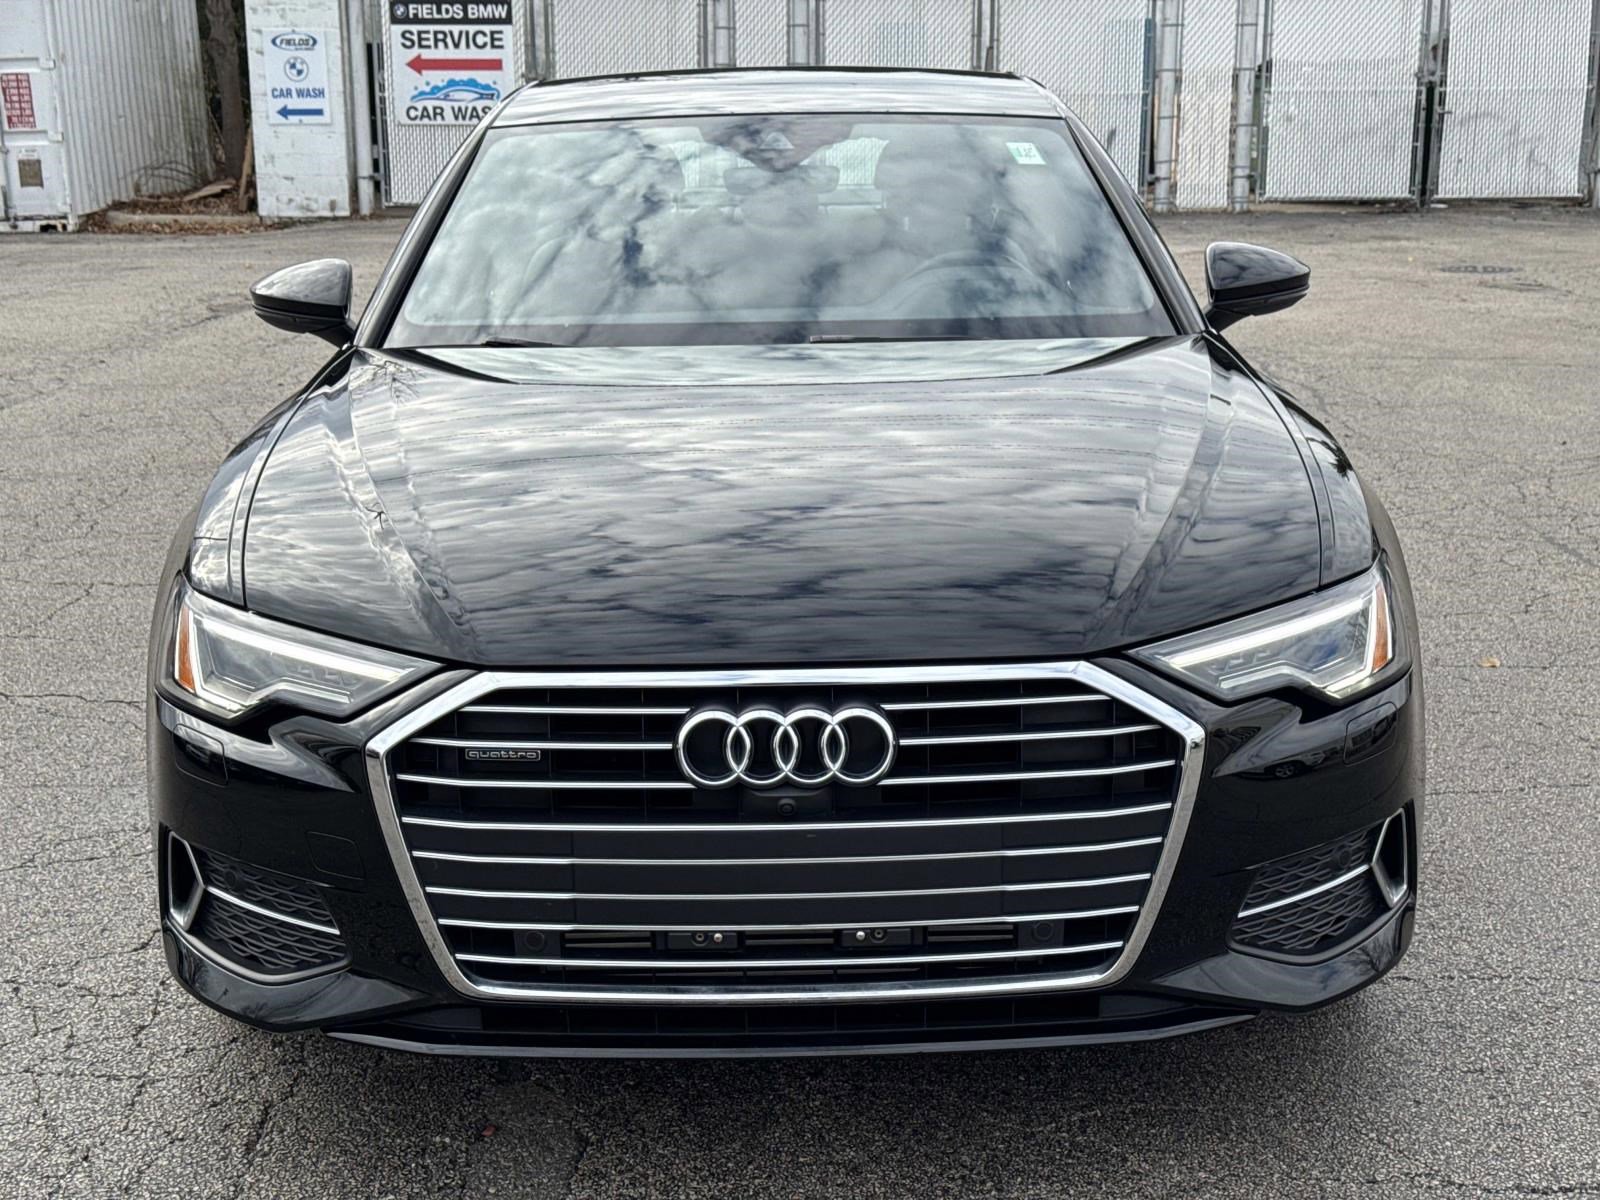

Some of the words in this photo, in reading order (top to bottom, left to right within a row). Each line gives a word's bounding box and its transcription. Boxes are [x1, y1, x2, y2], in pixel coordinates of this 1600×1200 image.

[408, 3, 464, 19] FIELDS
[467, 3, 508, 19] BMW
[279, 37, 311, 47] FIELDS
[400, 29, 505, 50] SERVICE
[271, 87, 293, 99] CAR
[295, 87, 326, 99] WASH
[406, 105, 446, 122] CAR
[450, 105, 493, 122] WAS
[468, 750, 537, 760] quattro
